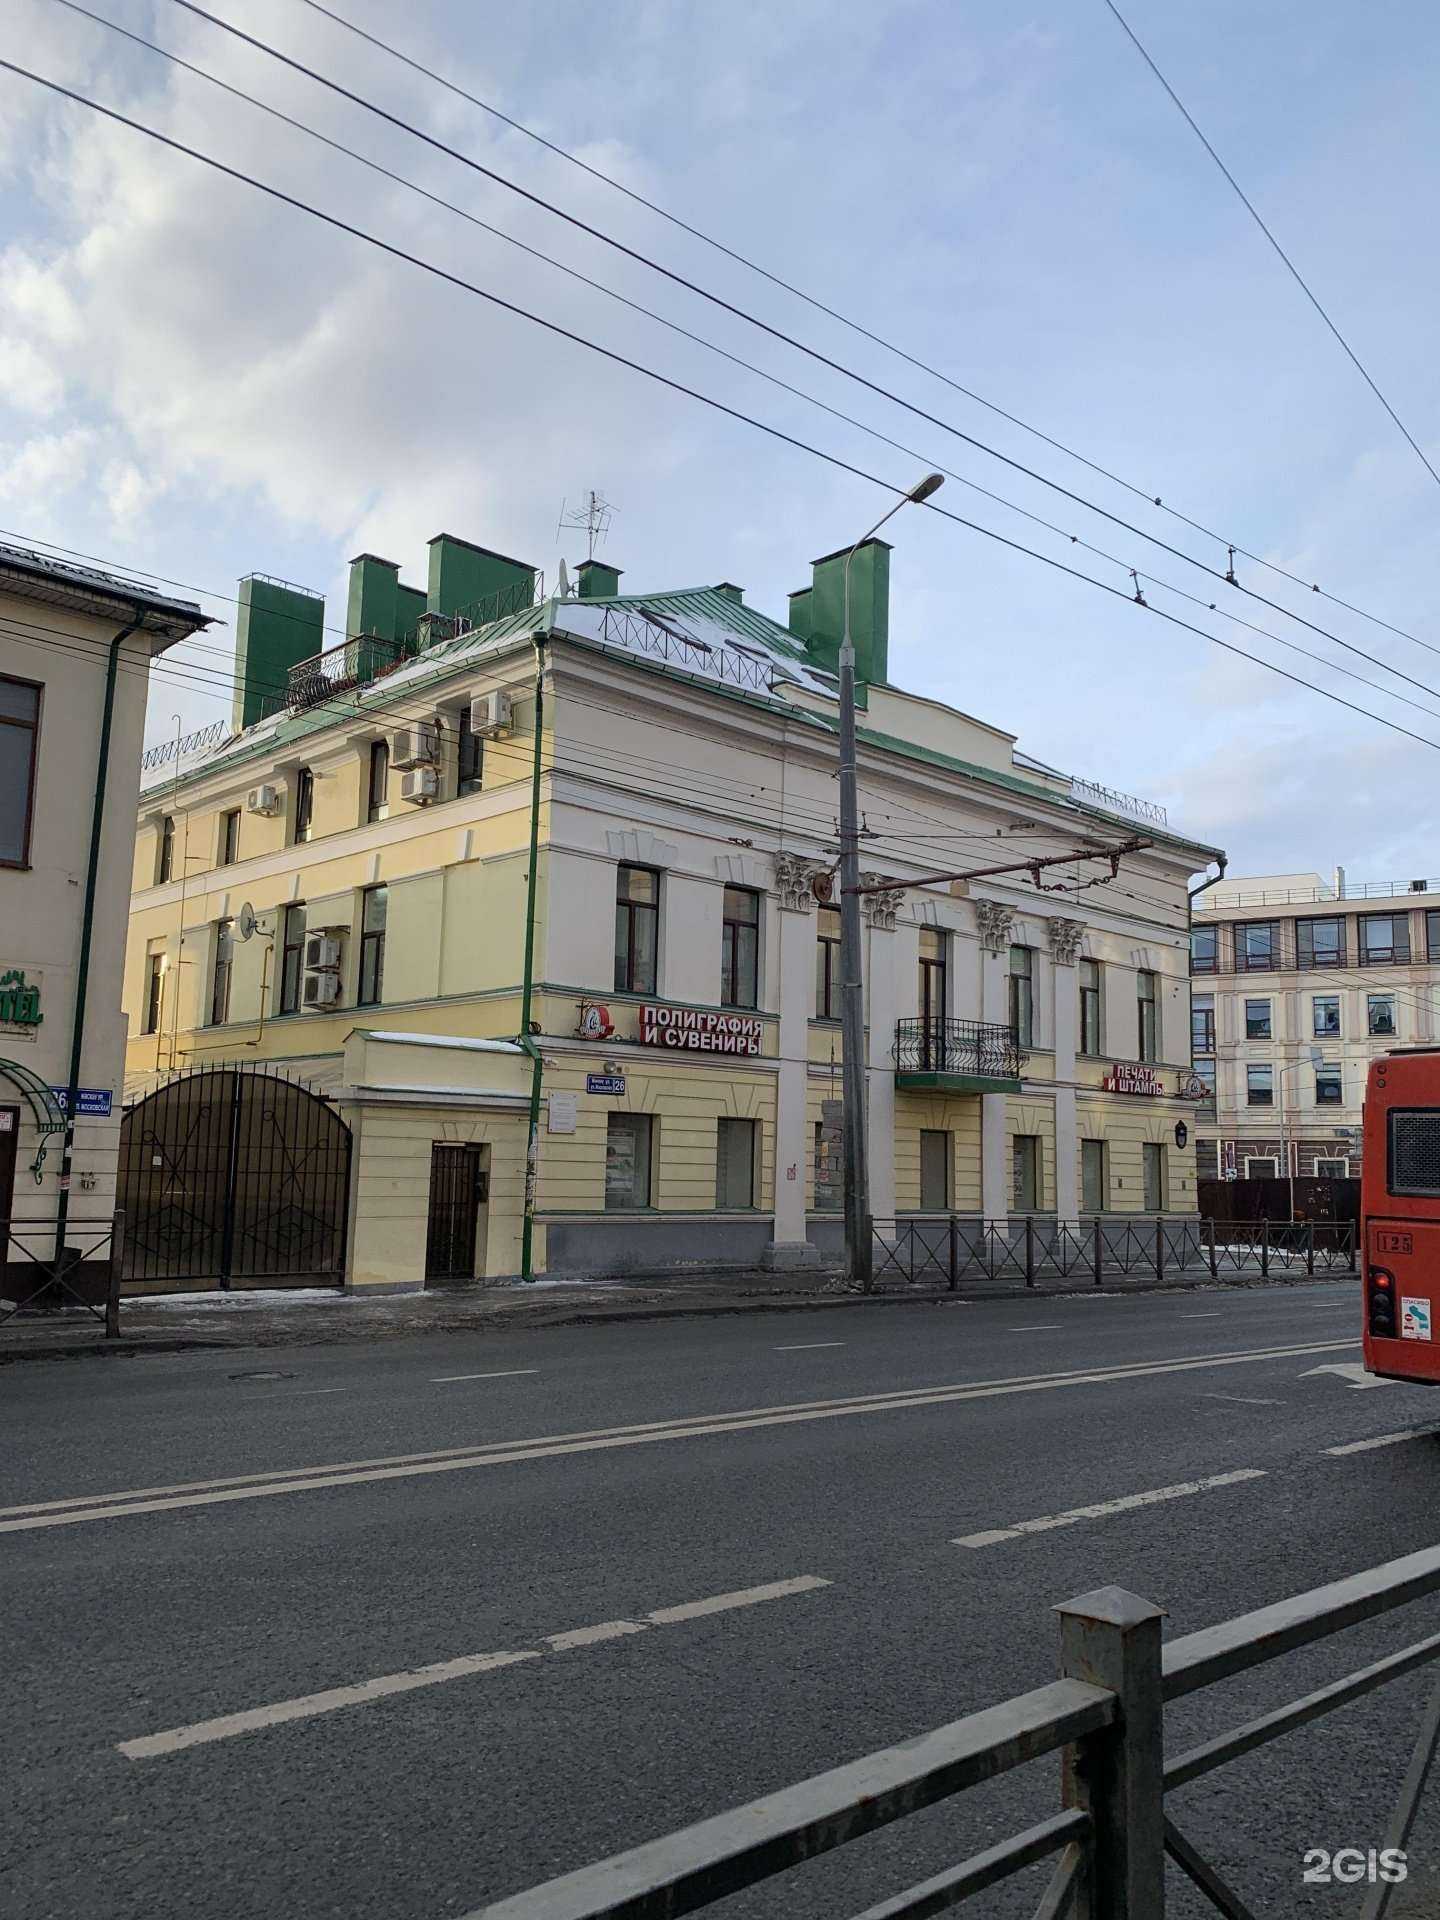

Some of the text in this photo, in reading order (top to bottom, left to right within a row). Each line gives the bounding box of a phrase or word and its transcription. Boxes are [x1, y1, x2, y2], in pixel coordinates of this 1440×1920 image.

[644, 1006, 764, 1037] ПОЛИГРАФИЯ
[645, 1025, 763, 1056] И СУВЕНИРЫ
[1117, 1065, 1157, 1081] ПЕЧАТИ
[615, 1080, 625, 1091] 26
[1108, 1078, 1115, 1090] И
[1119, 1079, 1167, 1096] ШТАМПЫ
[1381, 1235, 1410, 1252] 125
